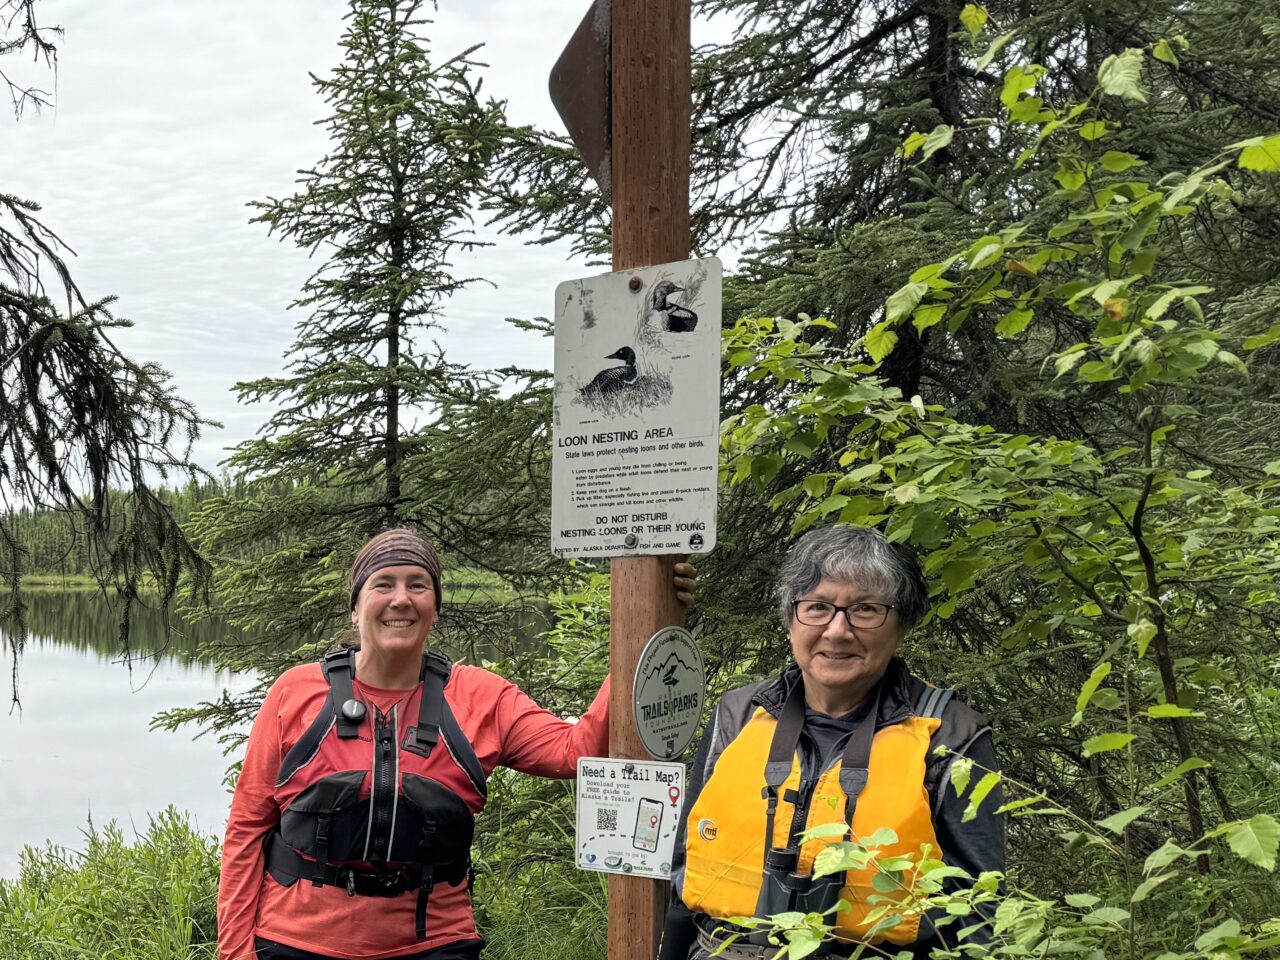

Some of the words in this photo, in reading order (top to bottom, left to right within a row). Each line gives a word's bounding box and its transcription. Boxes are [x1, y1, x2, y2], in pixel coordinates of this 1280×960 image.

[559, 435, 588, 448] LOON
[592, 430, 639, 444] NESTING
[644, 427, 674, 440] AREA
[565, 451, 580, 459] State
[596, 448, 616, 457] protect
[618, 446, 639, 454] nesting
[671, 442, 687, 450] other
[596, 516, 608, 525] DO
[611, 514, 629, 524] NOT
[631, 511, 668, 523] DISTURB
[560, 528, 596, 538] NESTING
[599, 526, 628, 536] LOONS
[631, 525, 644, 534] OR
[647, 524, 672, 533] THEIR
[675, 522, 706, 532] YOUNG
[641, 700, 669, 721] TRAILS
[673, 692, 698, 713] PARKS
[644, 710, 696, 728] FOUNDATION
[582, 766, 605, 778] Need
[610, 769, 616, 779] a
[621, 768, 650, 782] Trail
[655, 770, 680, 787] Map?
[586, 780, 614, 788] Download
[581, 793, 609, 801] Alaska's
